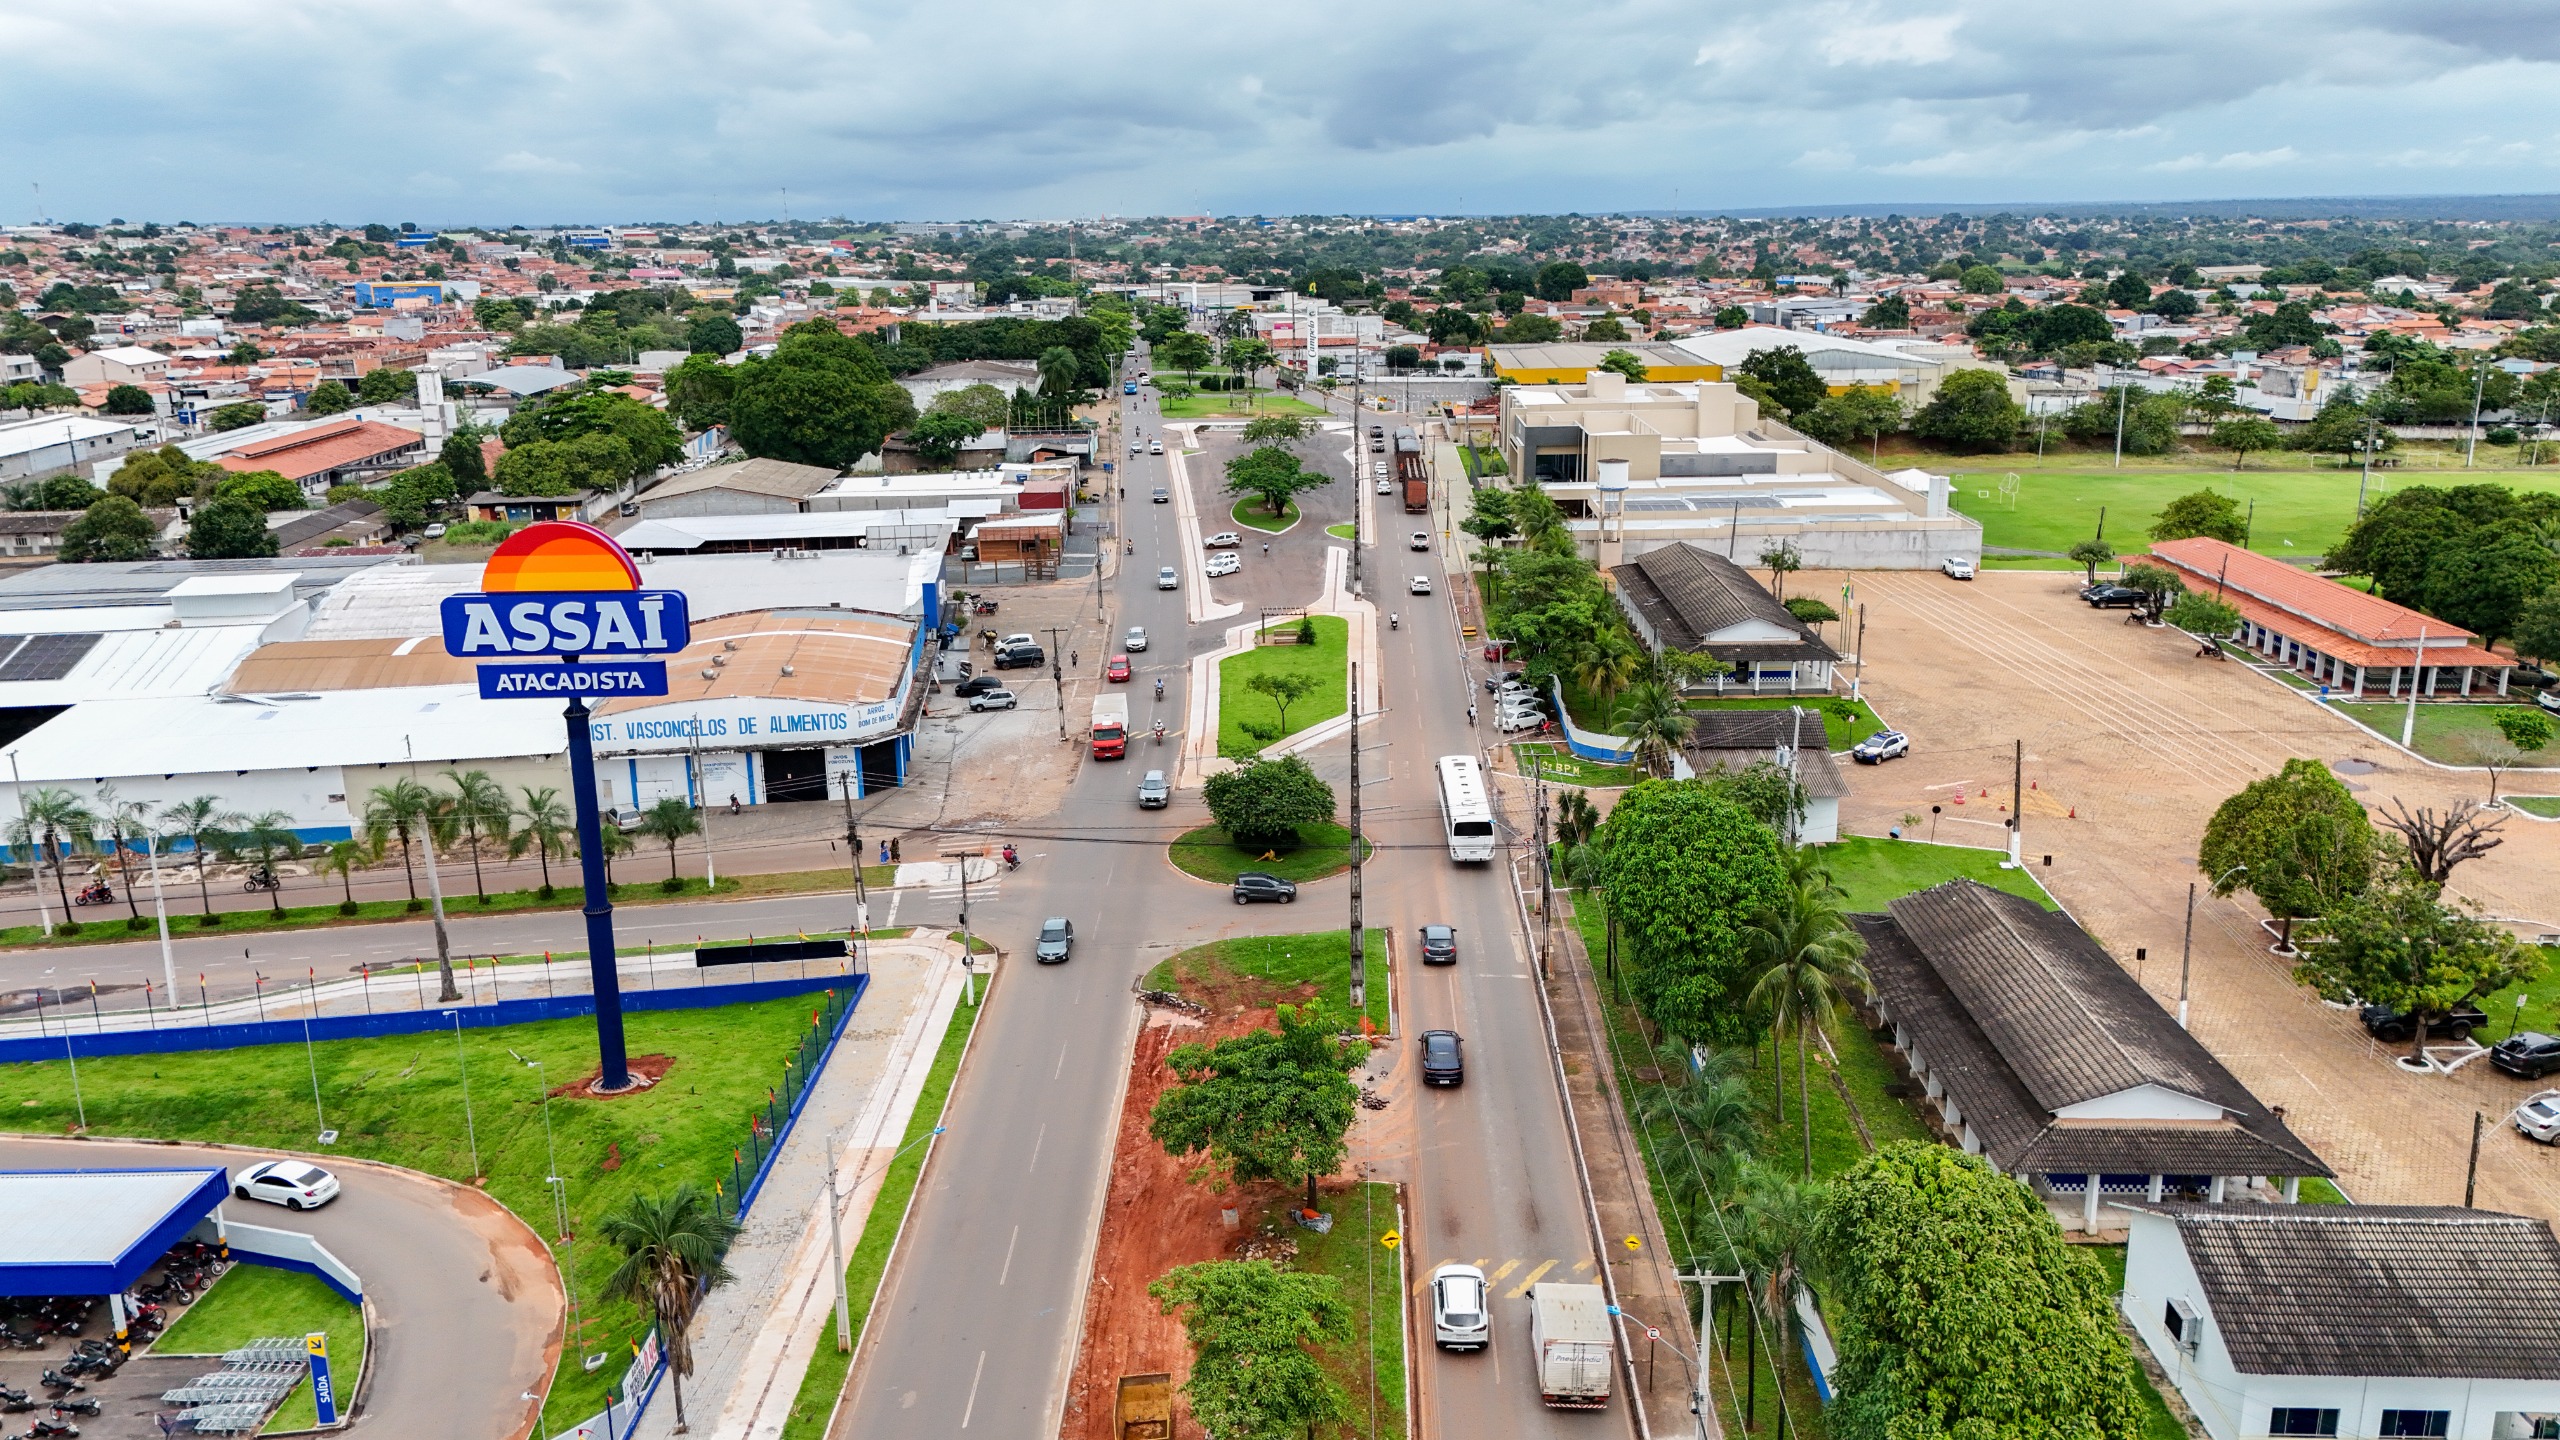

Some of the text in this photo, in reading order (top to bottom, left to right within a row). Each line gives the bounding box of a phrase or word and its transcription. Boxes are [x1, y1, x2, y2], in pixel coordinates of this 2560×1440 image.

[1307, 320, 1317, 358] Campelo
[462, 594, 669, 652] ASSAÍ
[496, 671, 645, 692] ATACADISTA
[858, 713, 895, 728] BOM DE MESA
[867, 705, 885, 716] ARROZ
[590, 712, 848, 741] IST. VASCONCELOS DE ALIMENTOS
[316, 1375, 331, 1403] SAÍDA
